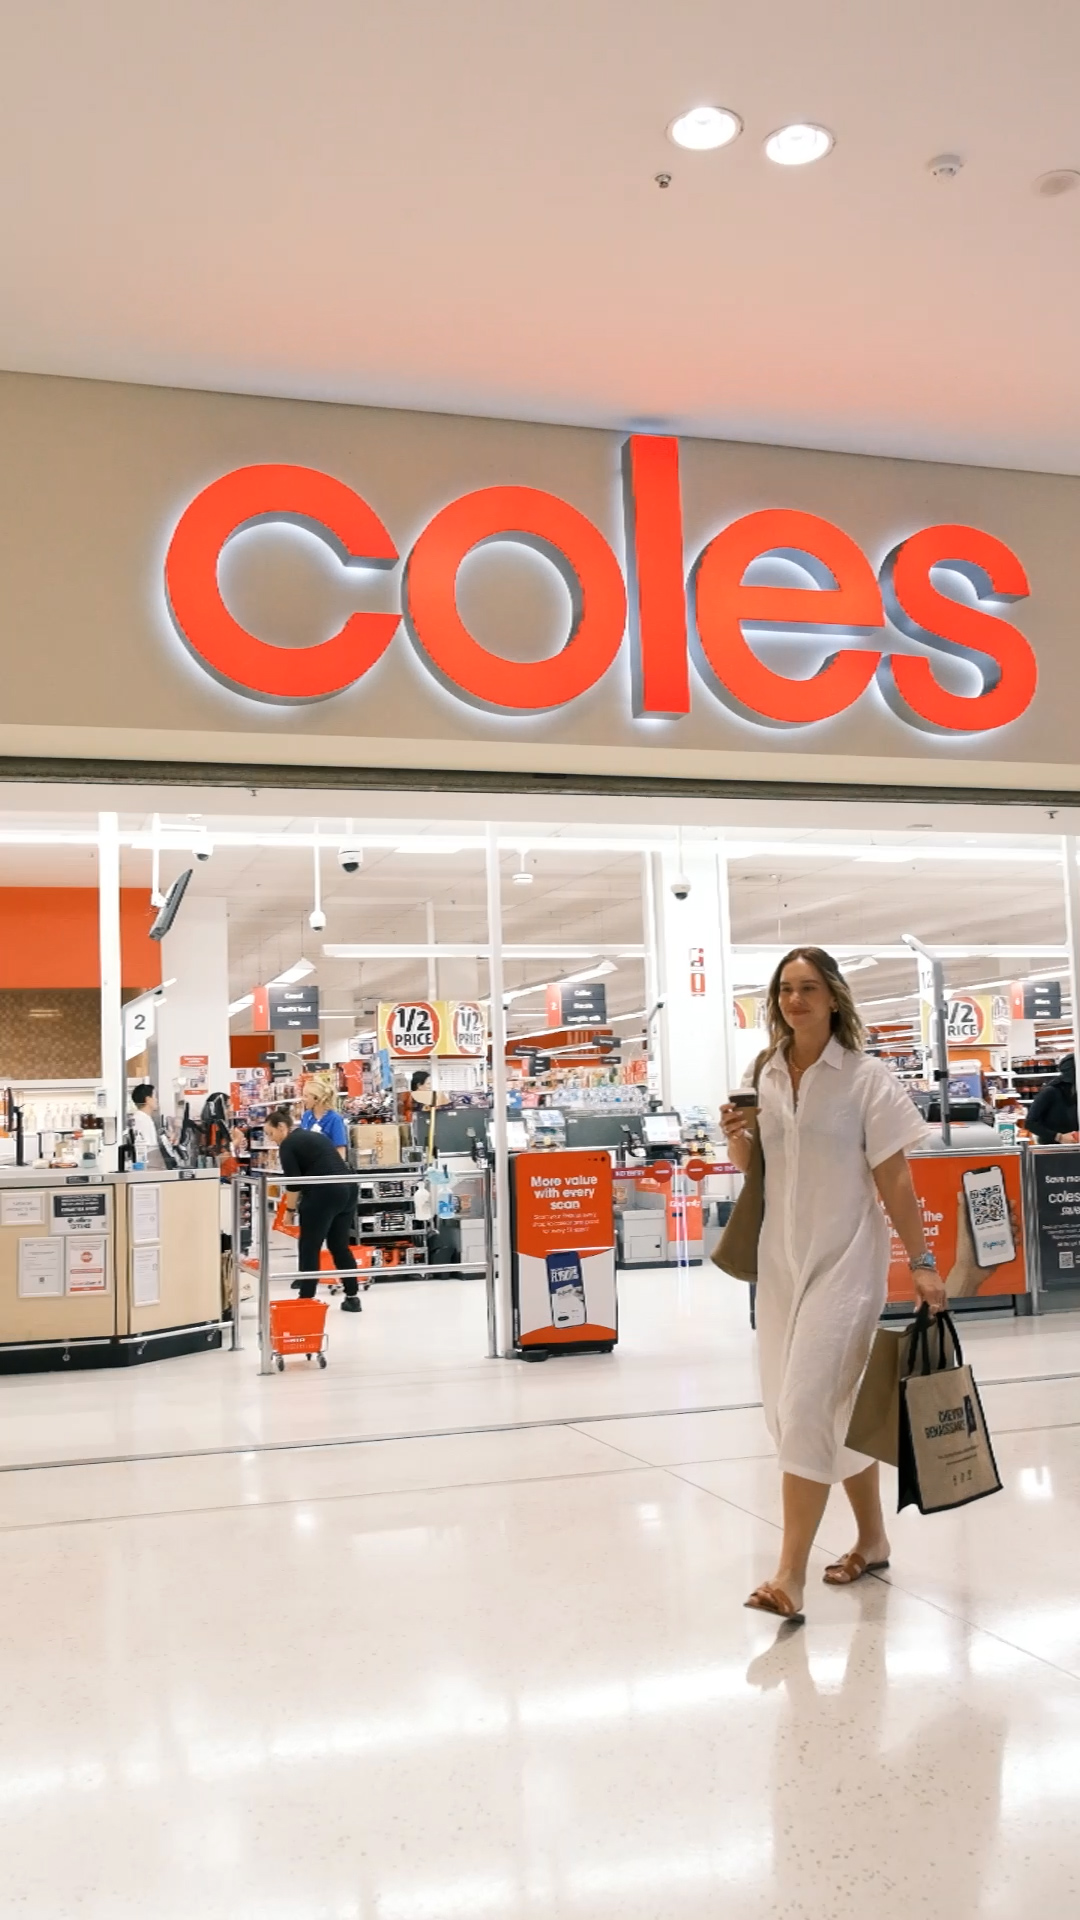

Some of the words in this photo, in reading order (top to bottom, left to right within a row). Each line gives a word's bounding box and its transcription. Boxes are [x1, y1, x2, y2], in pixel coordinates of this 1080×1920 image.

[164, 434, 1038, 735] coles
[134, 1014, 146, 1031] 2
[397, 1008, 430, 1032] 1/2
[947, 1024, 977, 1036] RICE
[394, 1033, 433, 1046] PRICE
[531, 1176, 562, 1187] More
[564, 1175, 598, 1186] value
[1045, 1175, 1066, 1184] Save
[1067, 1175, 1080, 1183] mo
[534, 1187, 560, 1199] with
[562, 1188, 595, 1199] every
[1048, 1190, 1080, 1204] coles
[550, 1201, 580, 1210] scan
[923, 1210, 944, 1222] the
[922, 1224, 939, 1236] ad
